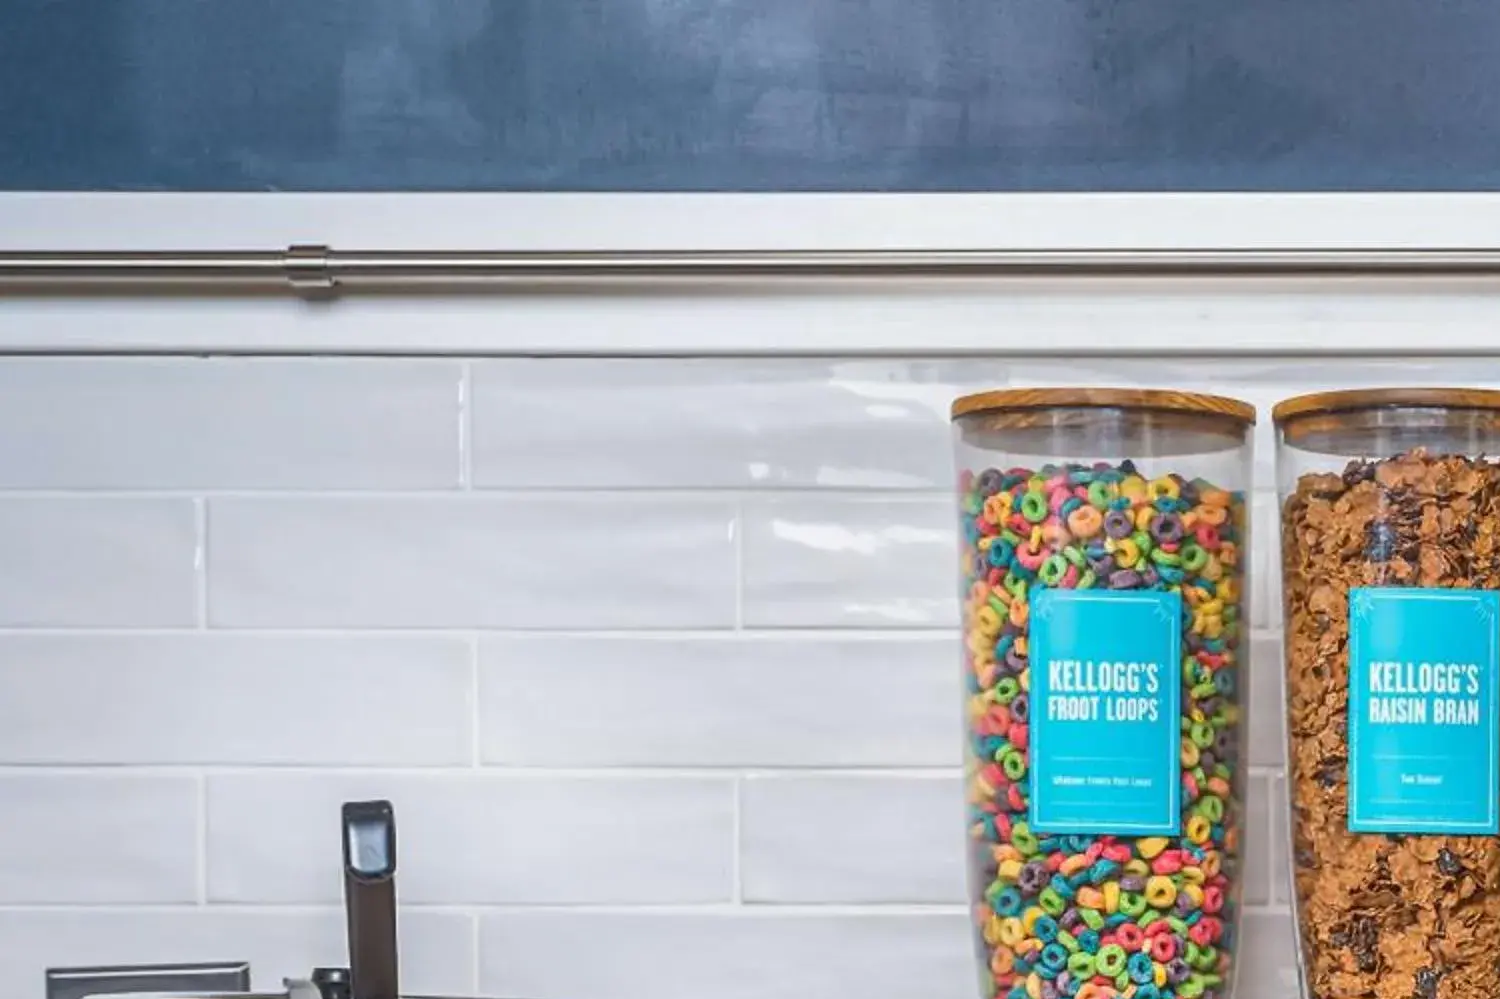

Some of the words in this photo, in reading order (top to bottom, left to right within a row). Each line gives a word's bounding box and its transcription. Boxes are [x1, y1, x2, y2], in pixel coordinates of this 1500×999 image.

[1048, 660, 1159, 692] KELLOGG'S
[1369, 661, 1479, 694] KELLOGG'S
[1048, 696, 1098, 721] FROOT
[1106, 697, 1159, 722] LOOPS
[1369, 698, 1426, 724] RAISIN
[1433, 699, 1479, 725] BRAN
